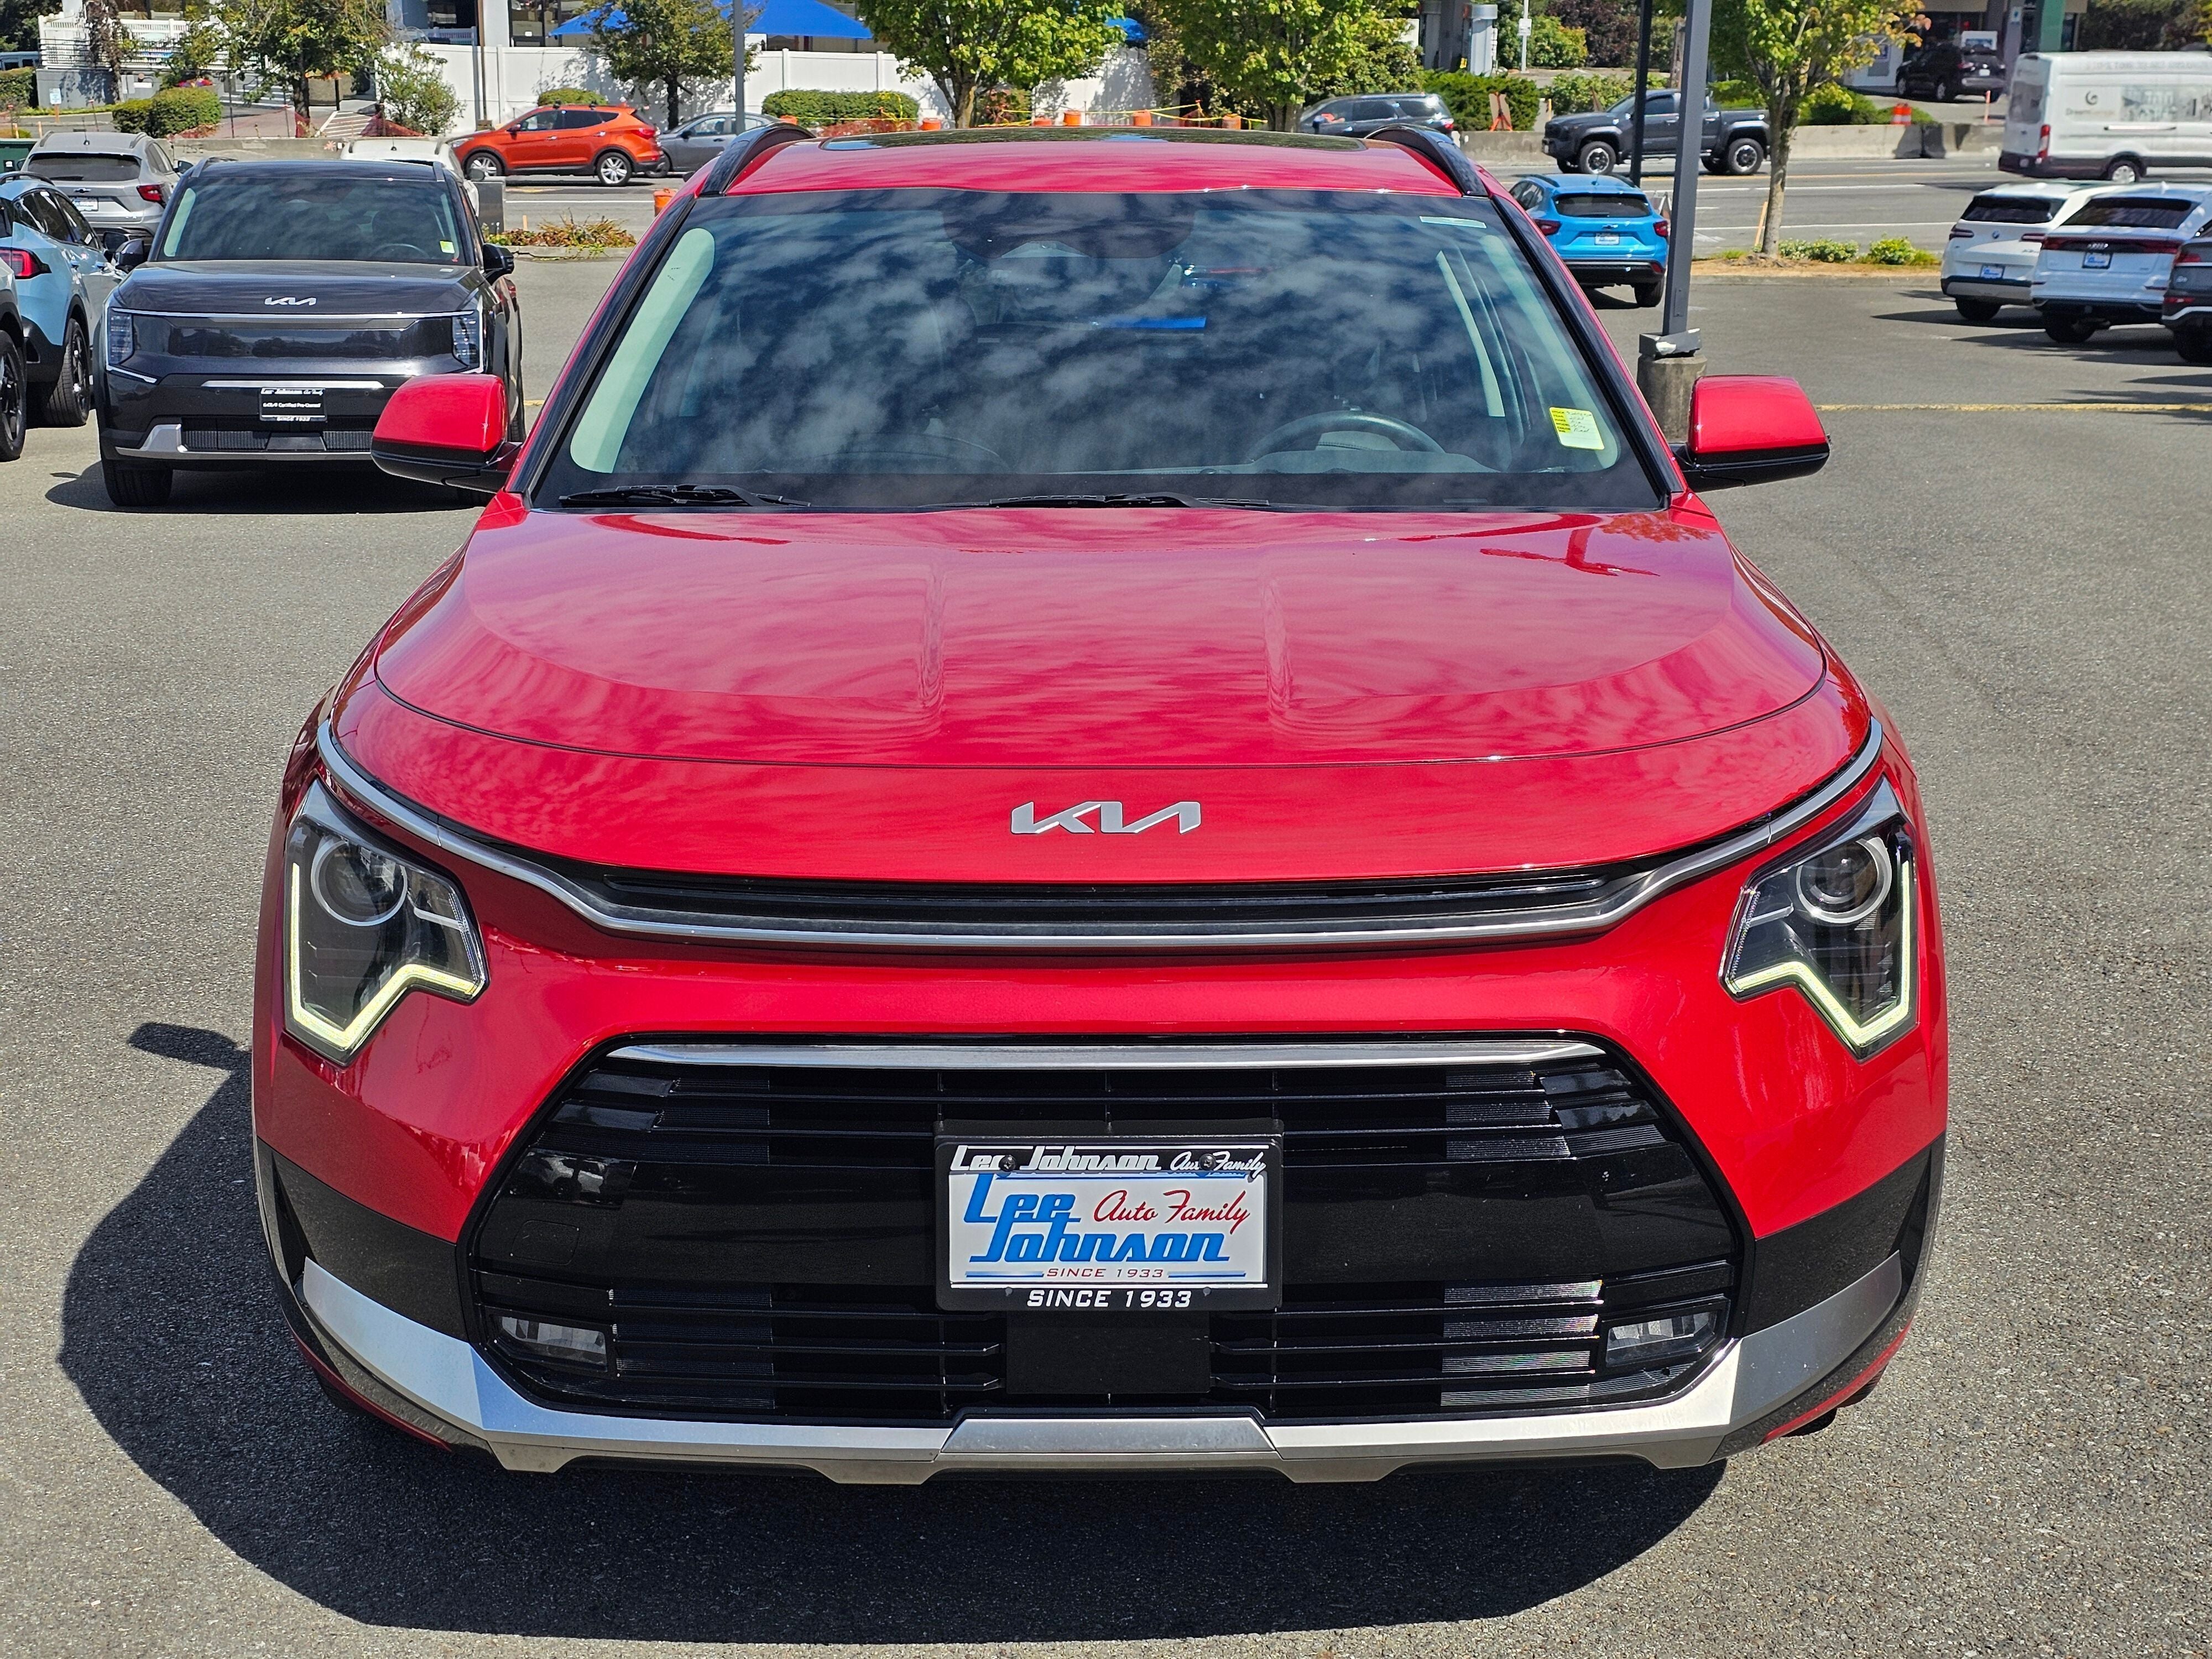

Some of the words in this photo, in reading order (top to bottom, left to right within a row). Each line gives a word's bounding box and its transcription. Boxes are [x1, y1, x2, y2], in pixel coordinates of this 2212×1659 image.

[264, 297, 316, 306] KIA
[1011, 801, 1201, 834] KIA
[1019, 1145, 1162, 1171] Johnson
[1212, 1151, 1267, 1178] Family
[963, 1173, 1082, 1223] Lee
[1093, 1190, 1159, 1222] Auto
[1162, 1190, 1251, 1235] Family
[969, 1212, 1230, 1262] Johnson
[1046, 1268, 1107, 1278] SINCE
[1117, 1268, 1164, 1278] 1933
[1026, 1289, 1112, 1307] SINCE
[1125, 1290, 1192, 1308] 1933
